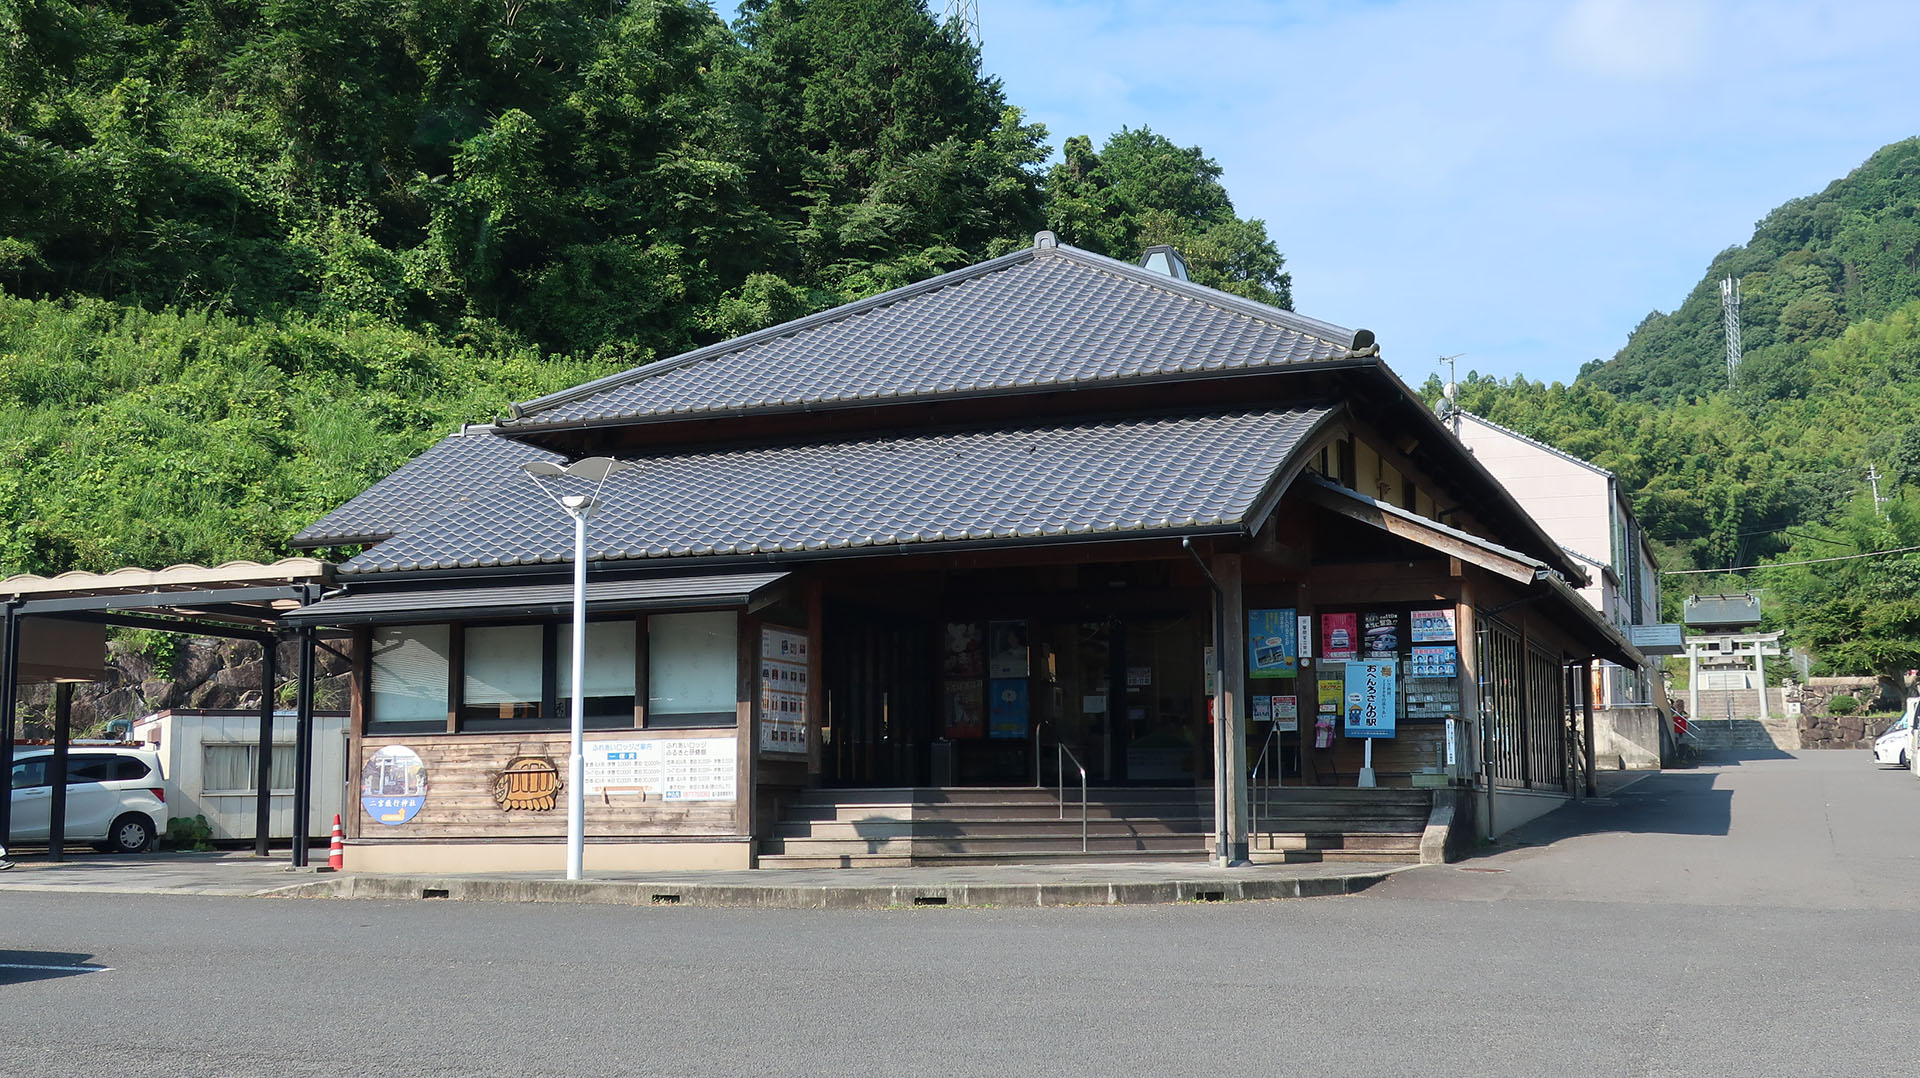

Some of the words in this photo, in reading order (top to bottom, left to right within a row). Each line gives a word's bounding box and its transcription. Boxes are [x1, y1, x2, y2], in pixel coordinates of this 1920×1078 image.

[1366, 664, 1377, 727] おへんろさんの駅
